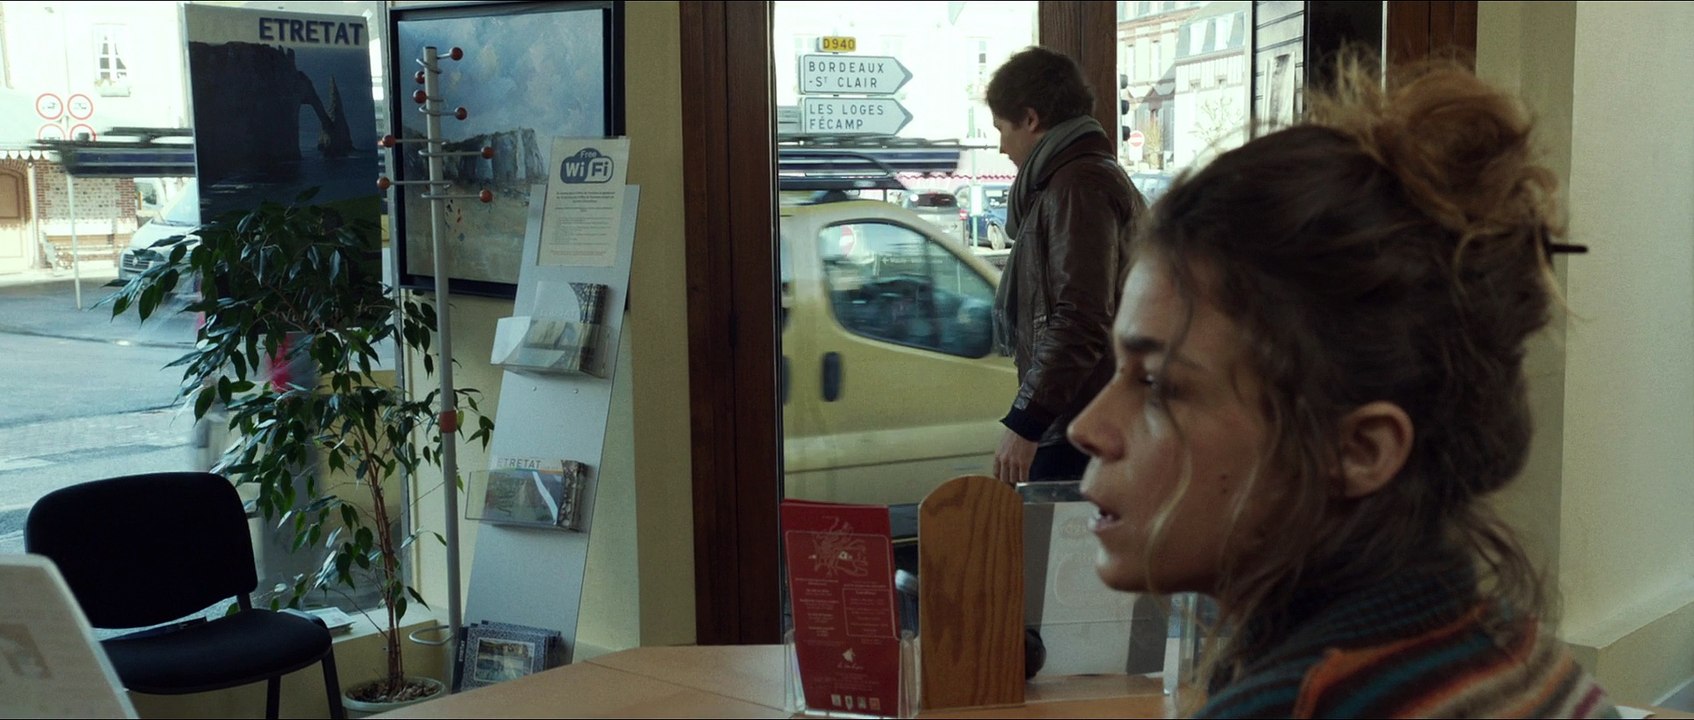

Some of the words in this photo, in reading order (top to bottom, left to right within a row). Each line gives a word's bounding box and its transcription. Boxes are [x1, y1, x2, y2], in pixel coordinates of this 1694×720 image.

[259, 17, 364, 45] ETRETAT
[809, 61, 885, 73] BORDEAUX
[837, 77, 878, 88] CLAIR
[809, 104, 834, 115] LES
[842, 104, 884, 116] LOGES
[809, 116, 864, 130] FÉCAMP
[580, 150, 598, 159] Free
